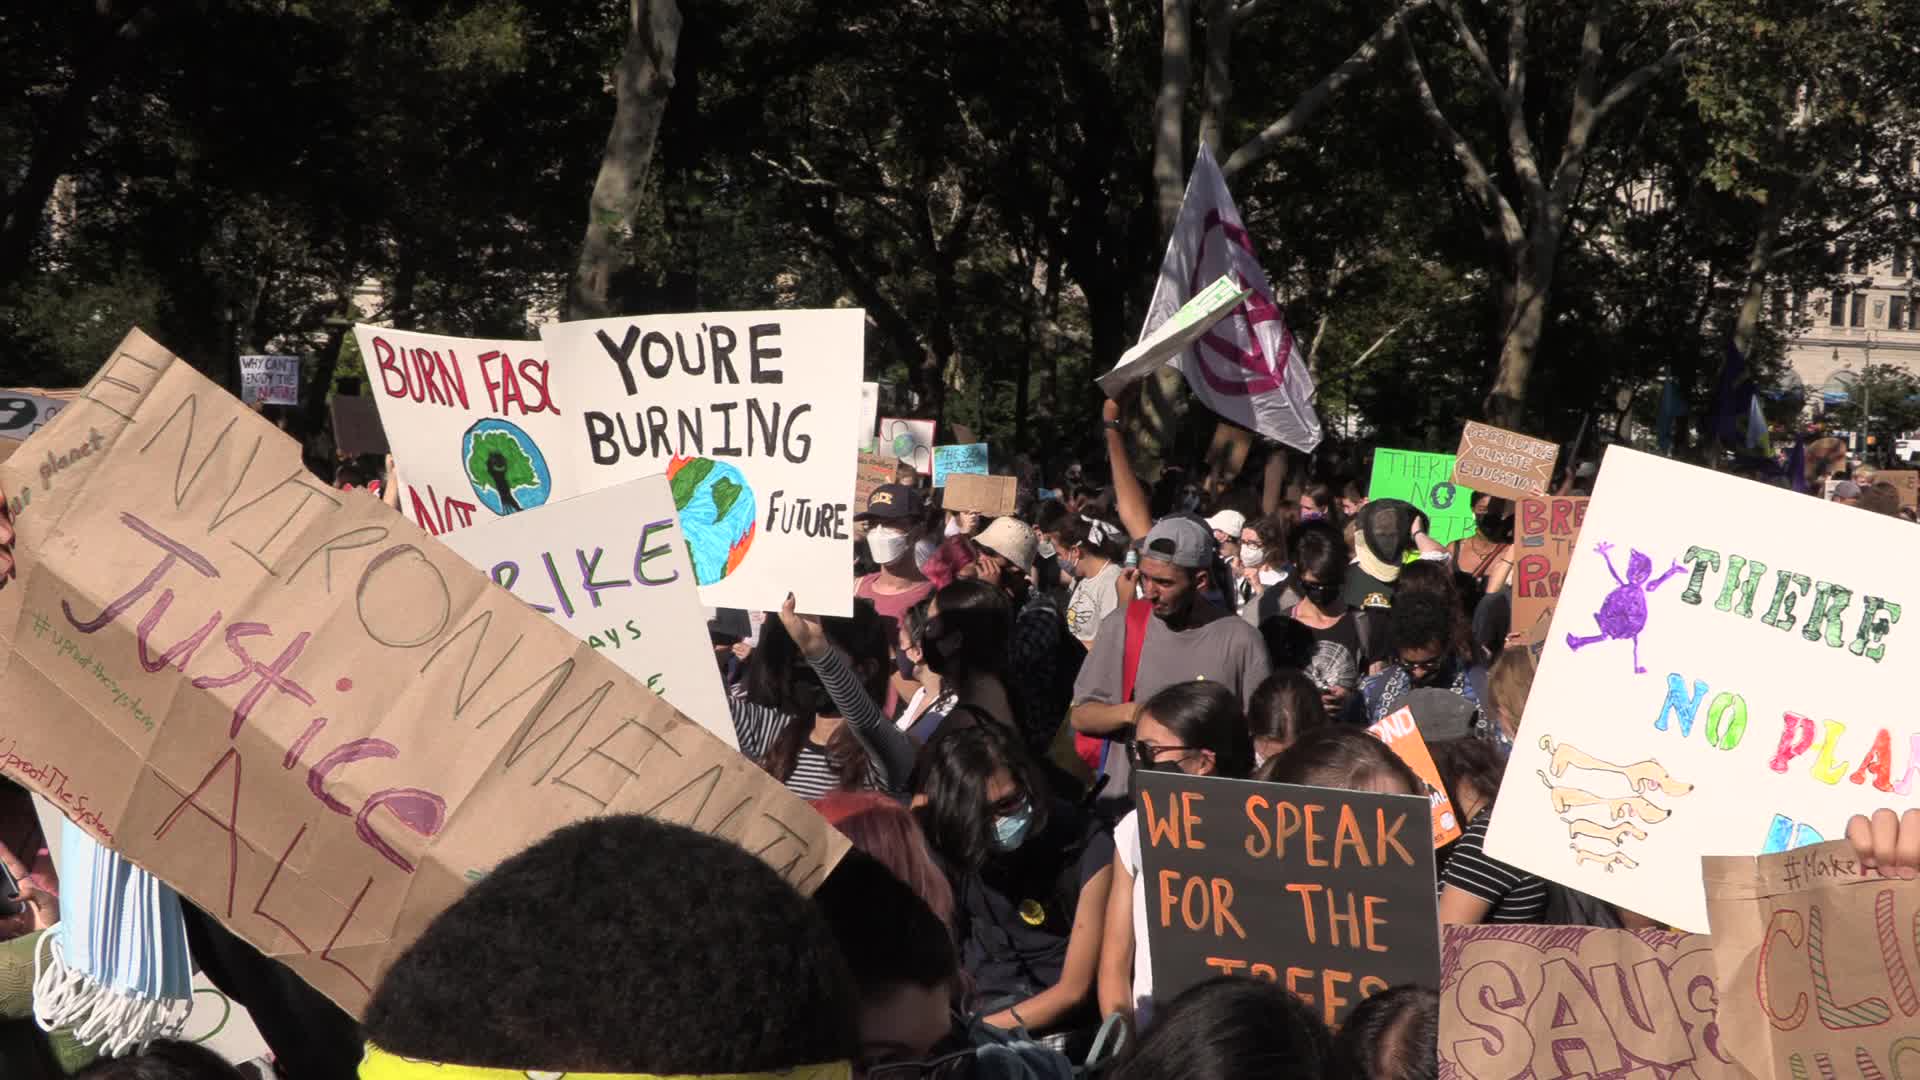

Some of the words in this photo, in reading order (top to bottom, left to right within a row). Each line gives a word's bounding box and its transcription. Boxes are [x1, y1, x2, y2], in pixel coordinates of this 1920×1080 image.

[242, 358, 264, 370] WHY
[373, 336, 469, 410] BURN
[595, 322, 783, 396] YOU'RE
[40, 426, 104, 490] planet
[584, 398, 812, 466] BURNING
[1473, 445, 1533, 471] CLIMATE
[765, 489, 849, 540] FUTURE
[1410, 481, 1457, 510] NO
[1682, 545, 1902, 663] THERE
[1654, 672, 1748, 751] NO
[1142, 789, 1206, 850] WE
[1244, 795, 1416, 869] SPEAK
[153, 746, 373, 992] ALL
[1159, 870, 1247, 939] FOR
[1285, 883, 1389, 952] THE
[1757, 888, 1920, 1032] CLI
